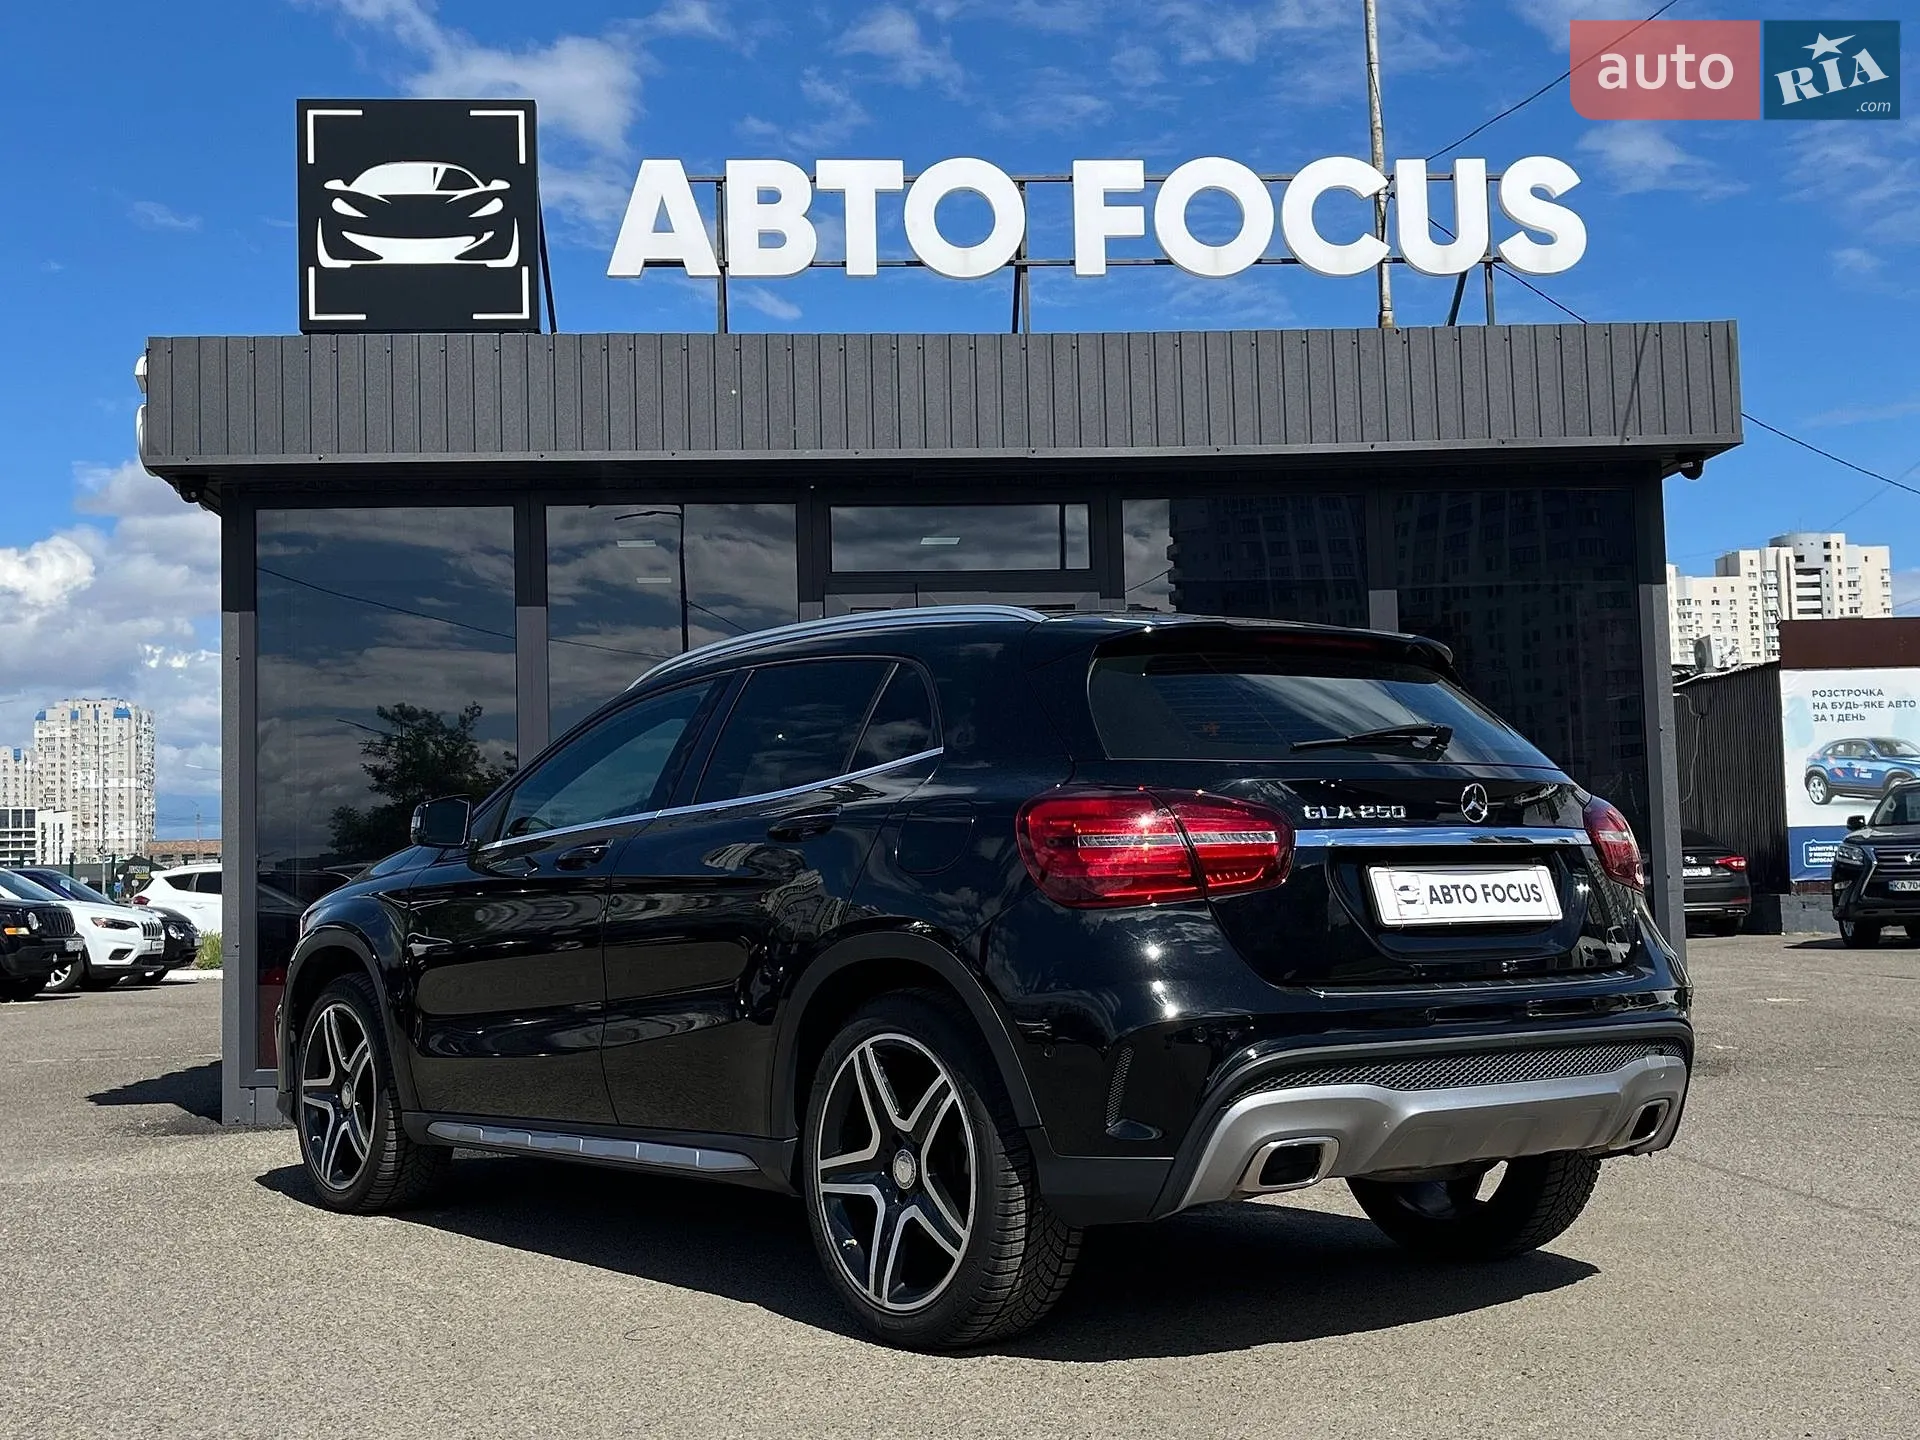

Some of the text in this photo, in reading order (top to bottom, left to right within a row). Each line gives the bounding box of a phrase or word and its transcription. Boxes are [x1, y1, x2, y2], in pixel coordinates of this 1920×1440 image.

[607, 155, 1588, 278] АВТО FOCUS
[1811, 688, 1884, 698] РОЗСТРОЧКА
[1812, 700, 1917, 710] НА БУДЬ-ЯКЕ АВТО
[1813, 714, 1828, 722] ЗА
[1837, 713, 1866, 723] ДЕНЬ
[1303, 805, 1407, 819] GLA 250
[1480, 883, 1543, 904] FOCUS
